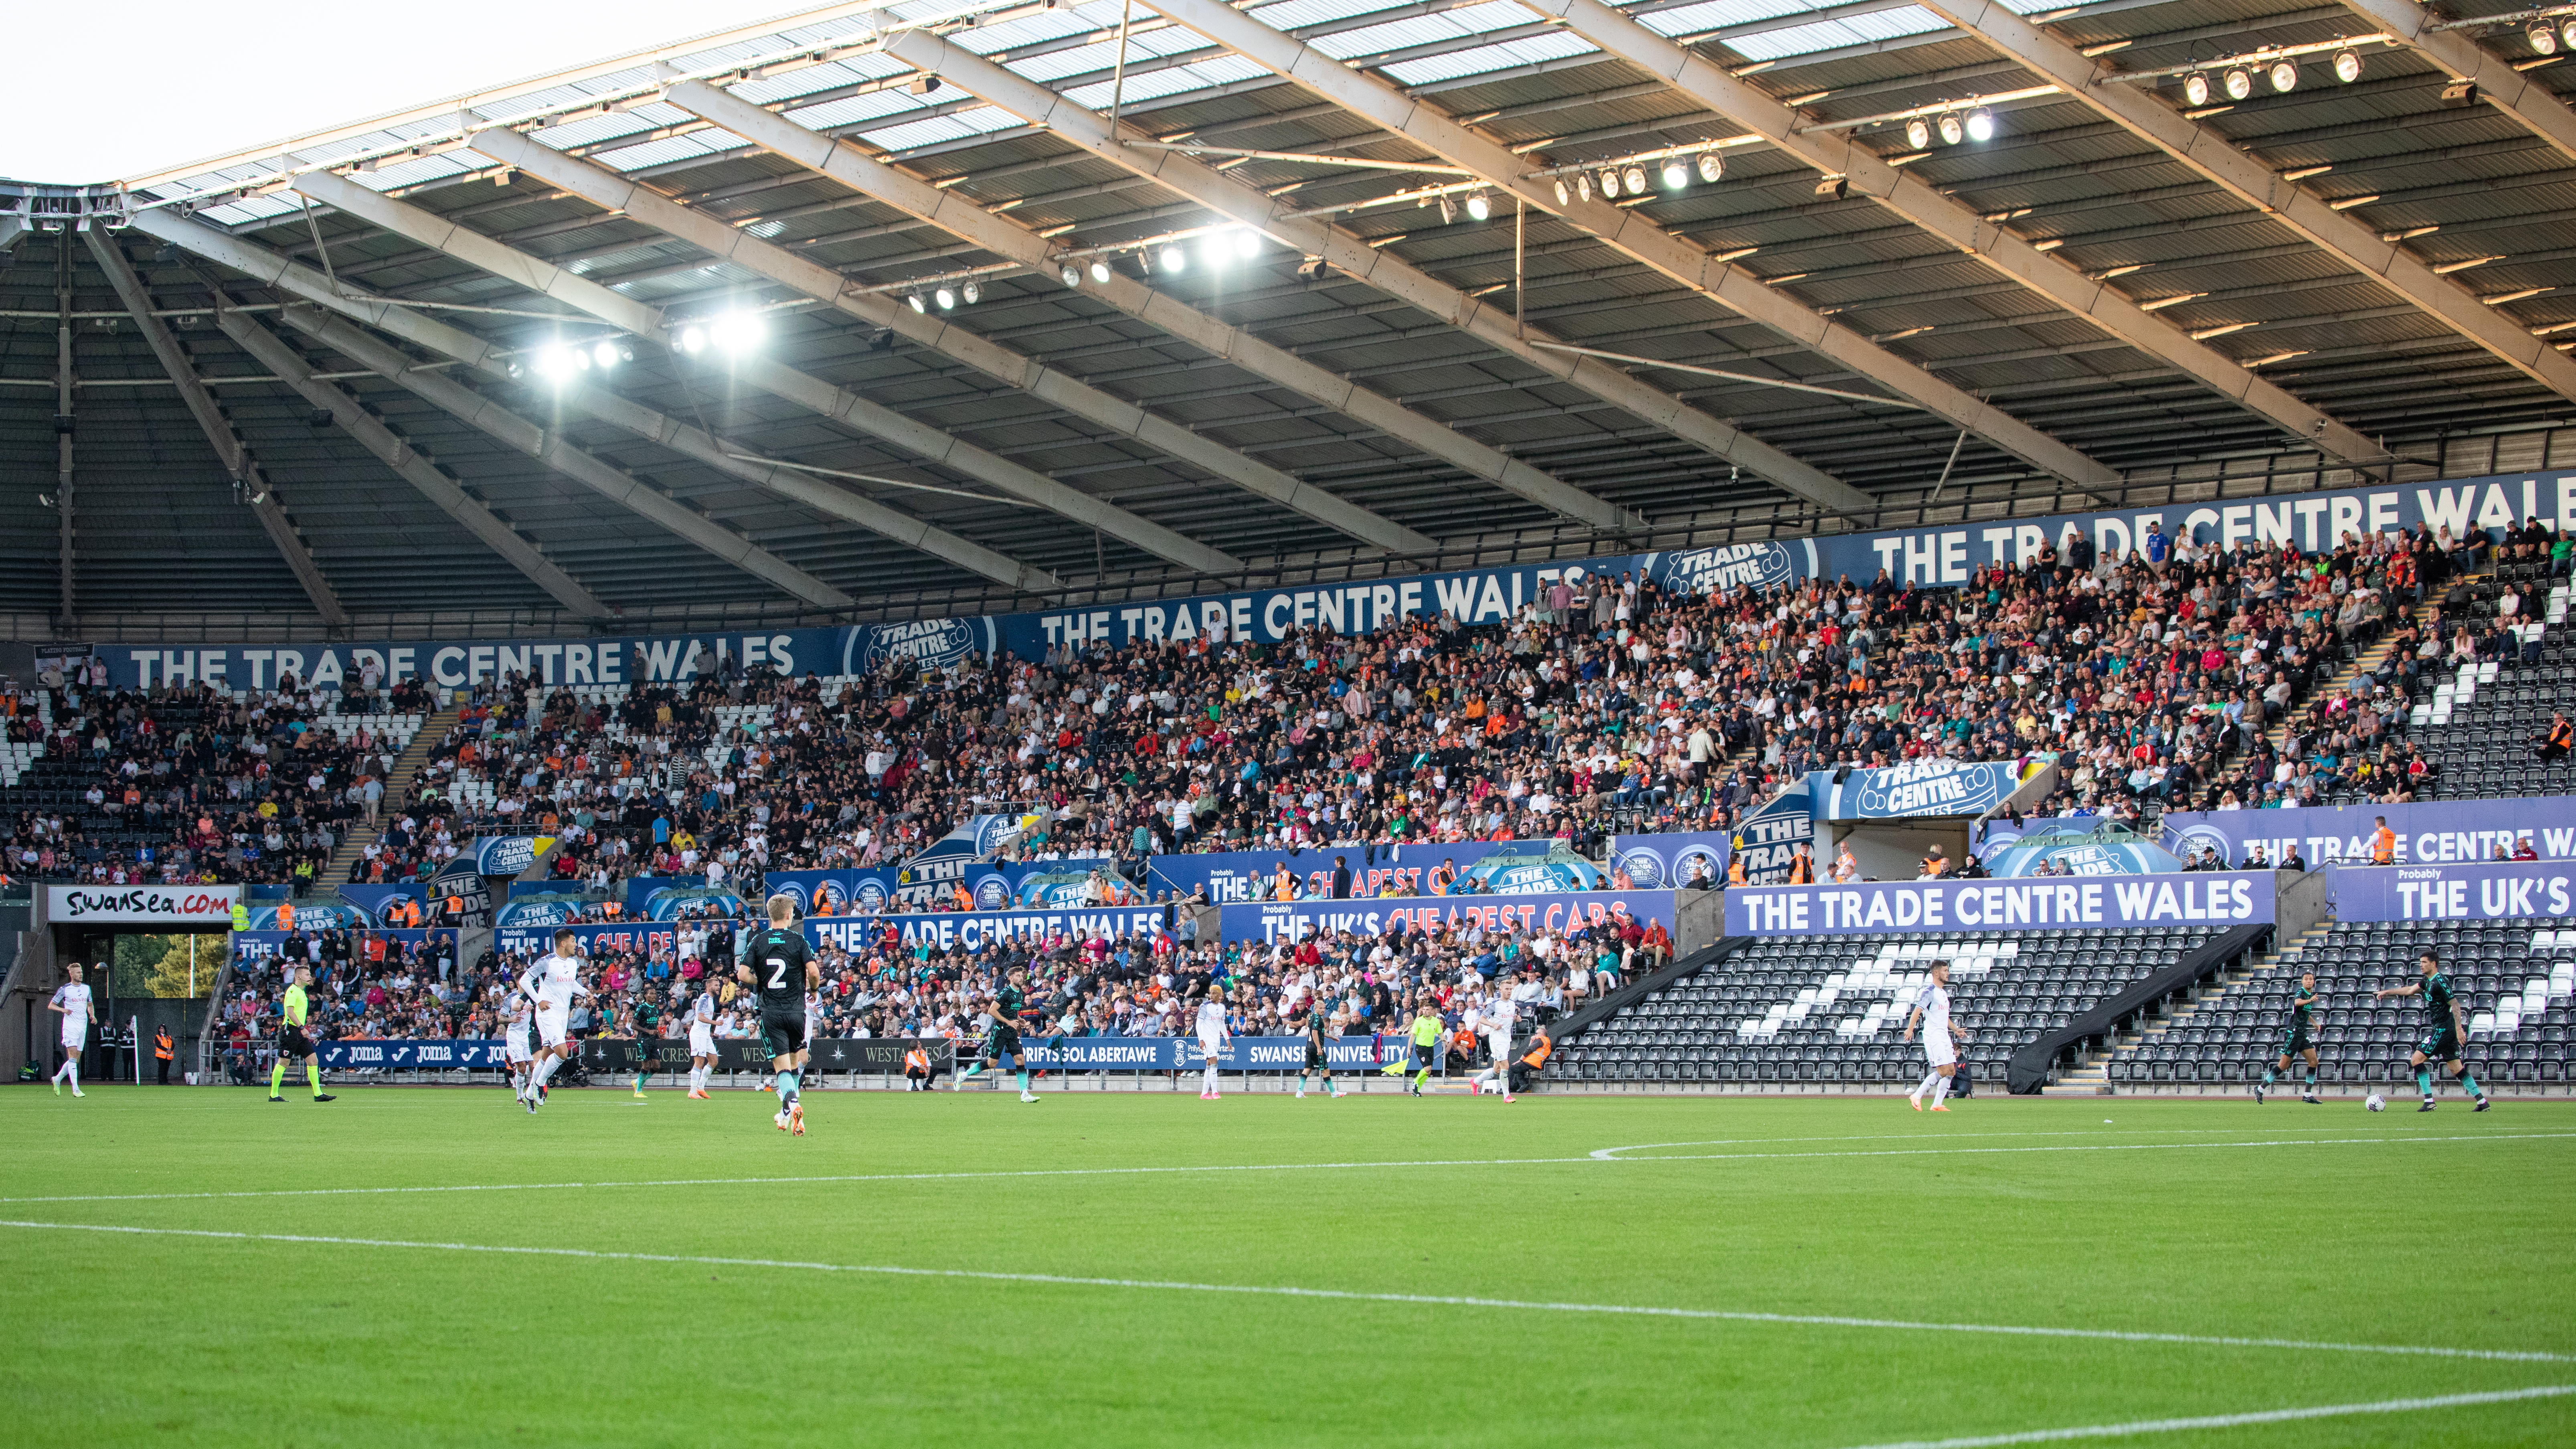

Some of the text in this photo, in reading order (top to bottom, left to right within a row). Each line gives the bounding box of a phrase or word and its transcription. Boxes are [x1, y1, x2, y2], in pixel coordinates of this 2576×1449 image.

[1873, 531, 1967, 584] THE
[1983, 513, 2163, 573] TRADE
[2184, 492, 2398, 561] CENTRE
[1681, 542, 1770, 575] TRADE
[1691, 559, 1765, 595] CENTRE
[1042, 611, 1110, 653] THE
[1121, 597, 1251, 644] TRADE
[1265, 581, 1422, 639] CENTRE
[880, 619, 956, 645] TRADE
[889, 632, 951, 664] CENTRE
[131, 635, 794, 689] THE TRADE CENTRE WALES
[1878, 763, 1974, 789] TRAD
[1888, 774, 1967, 813] CENTRE
[1751, 818, 1811, 842] THE
[995, 833, 1016, 847] CEN
[2244, 838, 2298, 866] THE
[2307, 834, 2407, 865] TRAE
[2416, 829, 2534, 862] CENTRE
[497, 845, 534, 856] TRADE
[1734, 840, 1815, 871] TRAD
[2055, 848, 2097, 862] THE
[502, 854, 533, 866] CENTRE
[2073, 860, 2115, 875] ADE
[1509, 868, 1545, 883] THE
[1747, 869, 1788, 886] CEN
[2398, 868, 2441, 880] Probably
[438, 876, 476, 897] THE
[897, 880, 965, 905] TRA
[1056, 885, 1086, 900] THE
[1210, 876, 1248, 902] THE
[1309, 867, 1421, 898] CHAPEST
[1499, 879, 1558, 894] TRADE
[1050, 898, 1084, 909] TRAD
[1742, 878, 2253, 931] THE TRADE CENTRE WALES
[2396, 876, 2570, 918] THE UK'S
[426, 894, 491, 921] TDE
[522, 905, 549, 918] THE
[680, 900, 704, 912] THE
[1263, 905, 1292, 915] Probably
[295, 918, 336, 930] ADE
[514, 915, 560, 927] TRADE
[1261, 900, 1627, 945] THE UK'S CHEAPEST CARS
[502, 929, 526, 937] Probably
[816, 912, 1163, 953] THE ADE CENTRE WALES
[239, 943, 273, 959] THE
[501, 937, 539, 959] THE
[594, 930, 677, 958] CHEAPE
[767, 959, 787, 988] 2
[487, 1046, 508, 1063] Jo
[624, 1048, 690, 1062] WCRES
[866, 1047, 939, 1062] WESTAES
[1089, 1047, 1156, 1062] ABERTAWE
[1188, 1045, 1204, 1053] Prifys
[1218, 1053, 1235, 1062] versity
[1250, 1046, 1306, 1063] SWANSE
